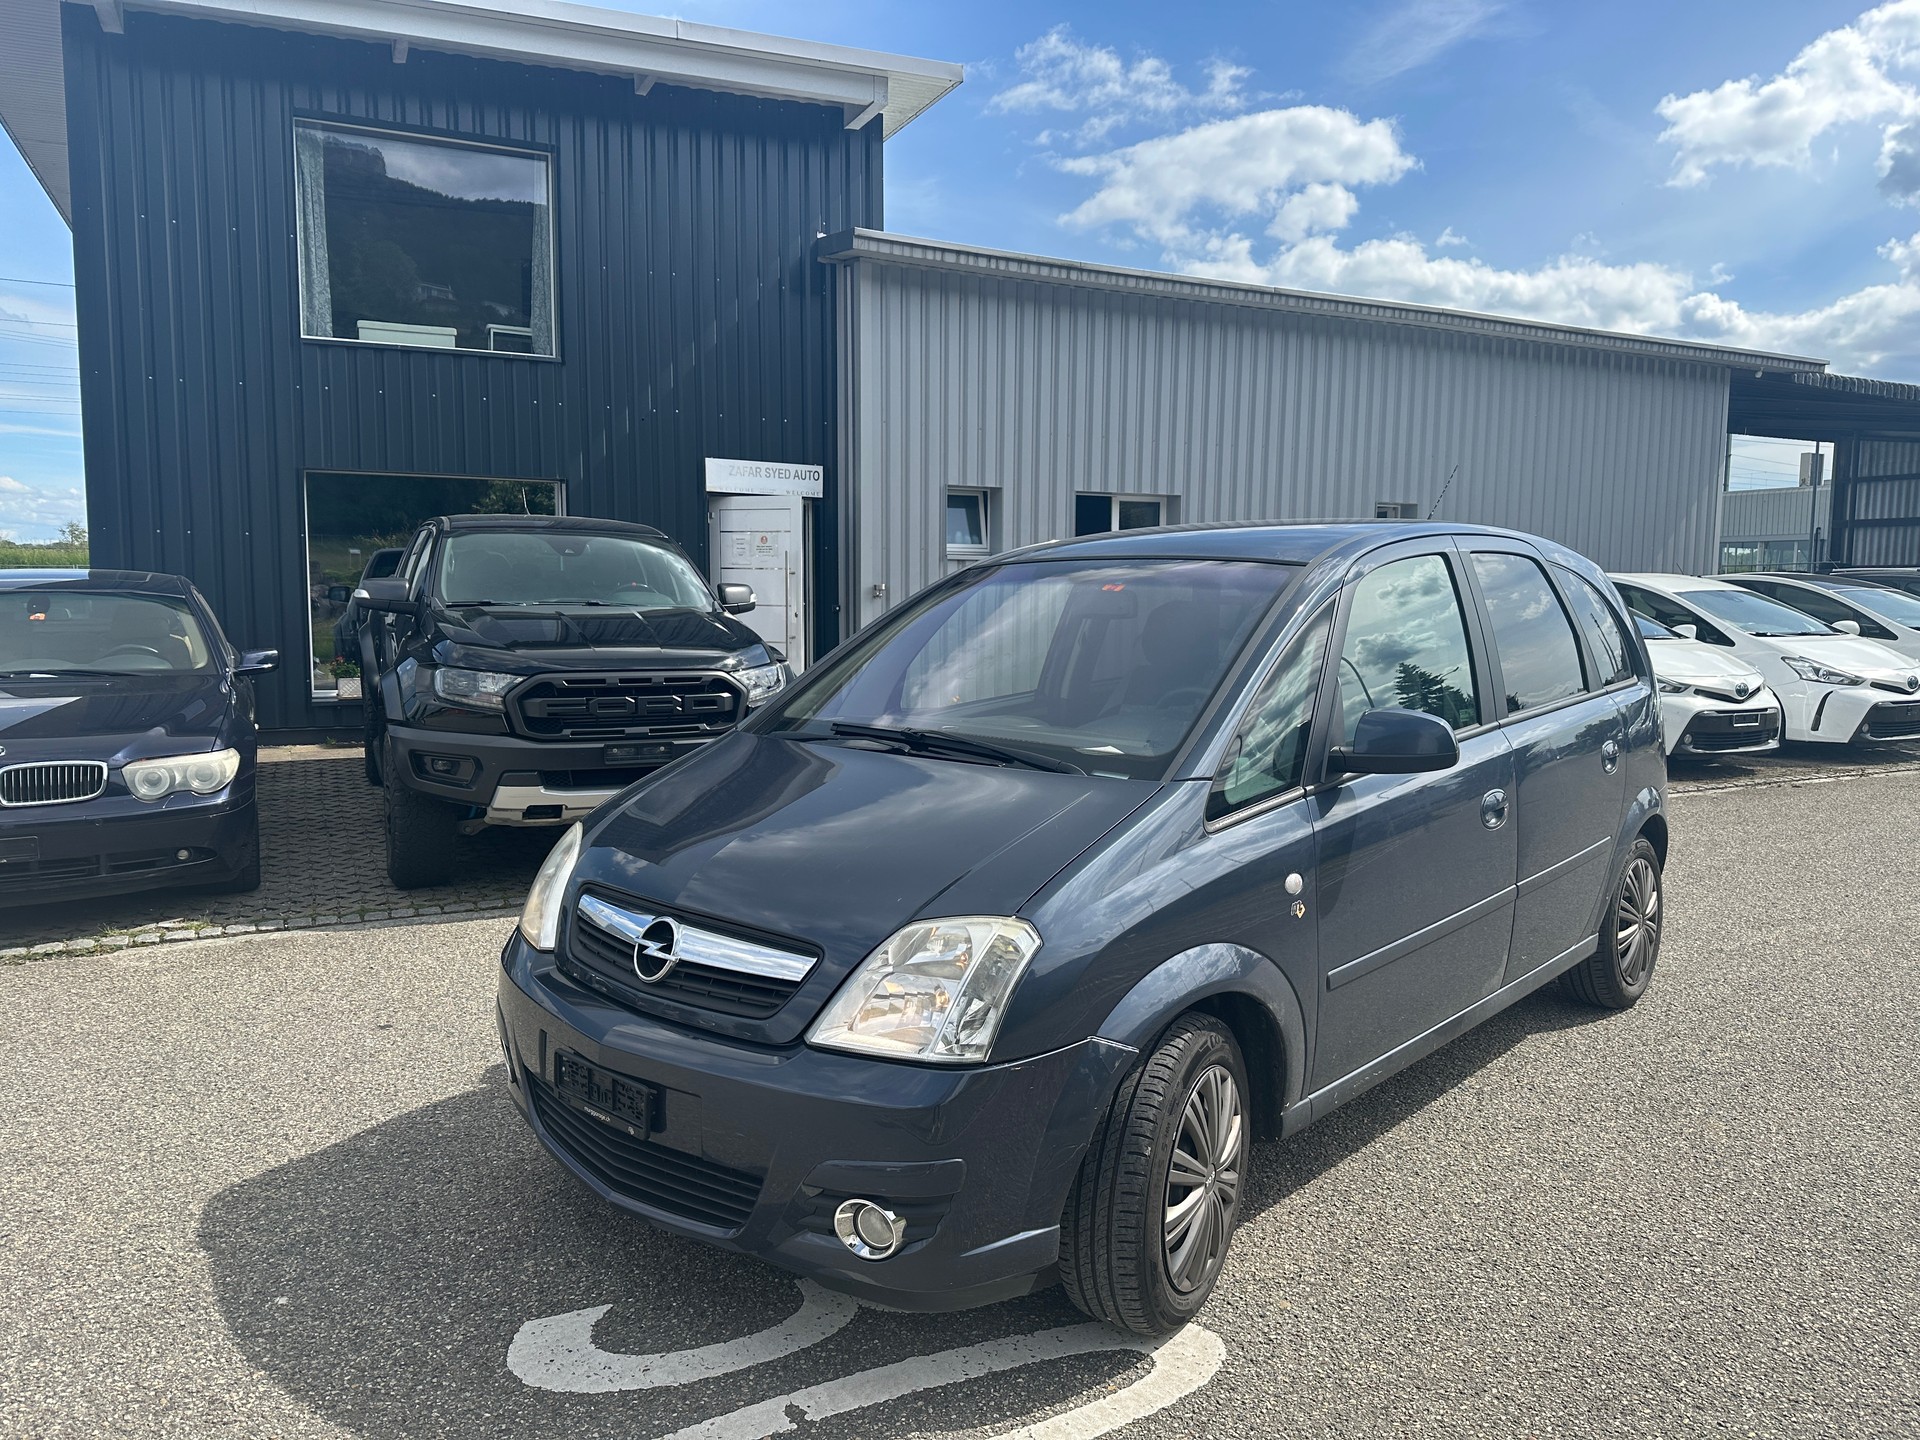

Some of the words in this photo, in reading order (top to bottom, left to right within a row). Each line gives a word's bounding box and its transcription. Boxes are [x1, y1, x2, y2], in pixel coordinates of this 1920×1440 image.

[728, 464, 762, 479] ZAFAR
[764, 467, 791, 480] SYED
[793, 469, 820, 482] AUTO
[785, 489, 820, 497] WELCOME
[525, 692, 732, 717] FORD
